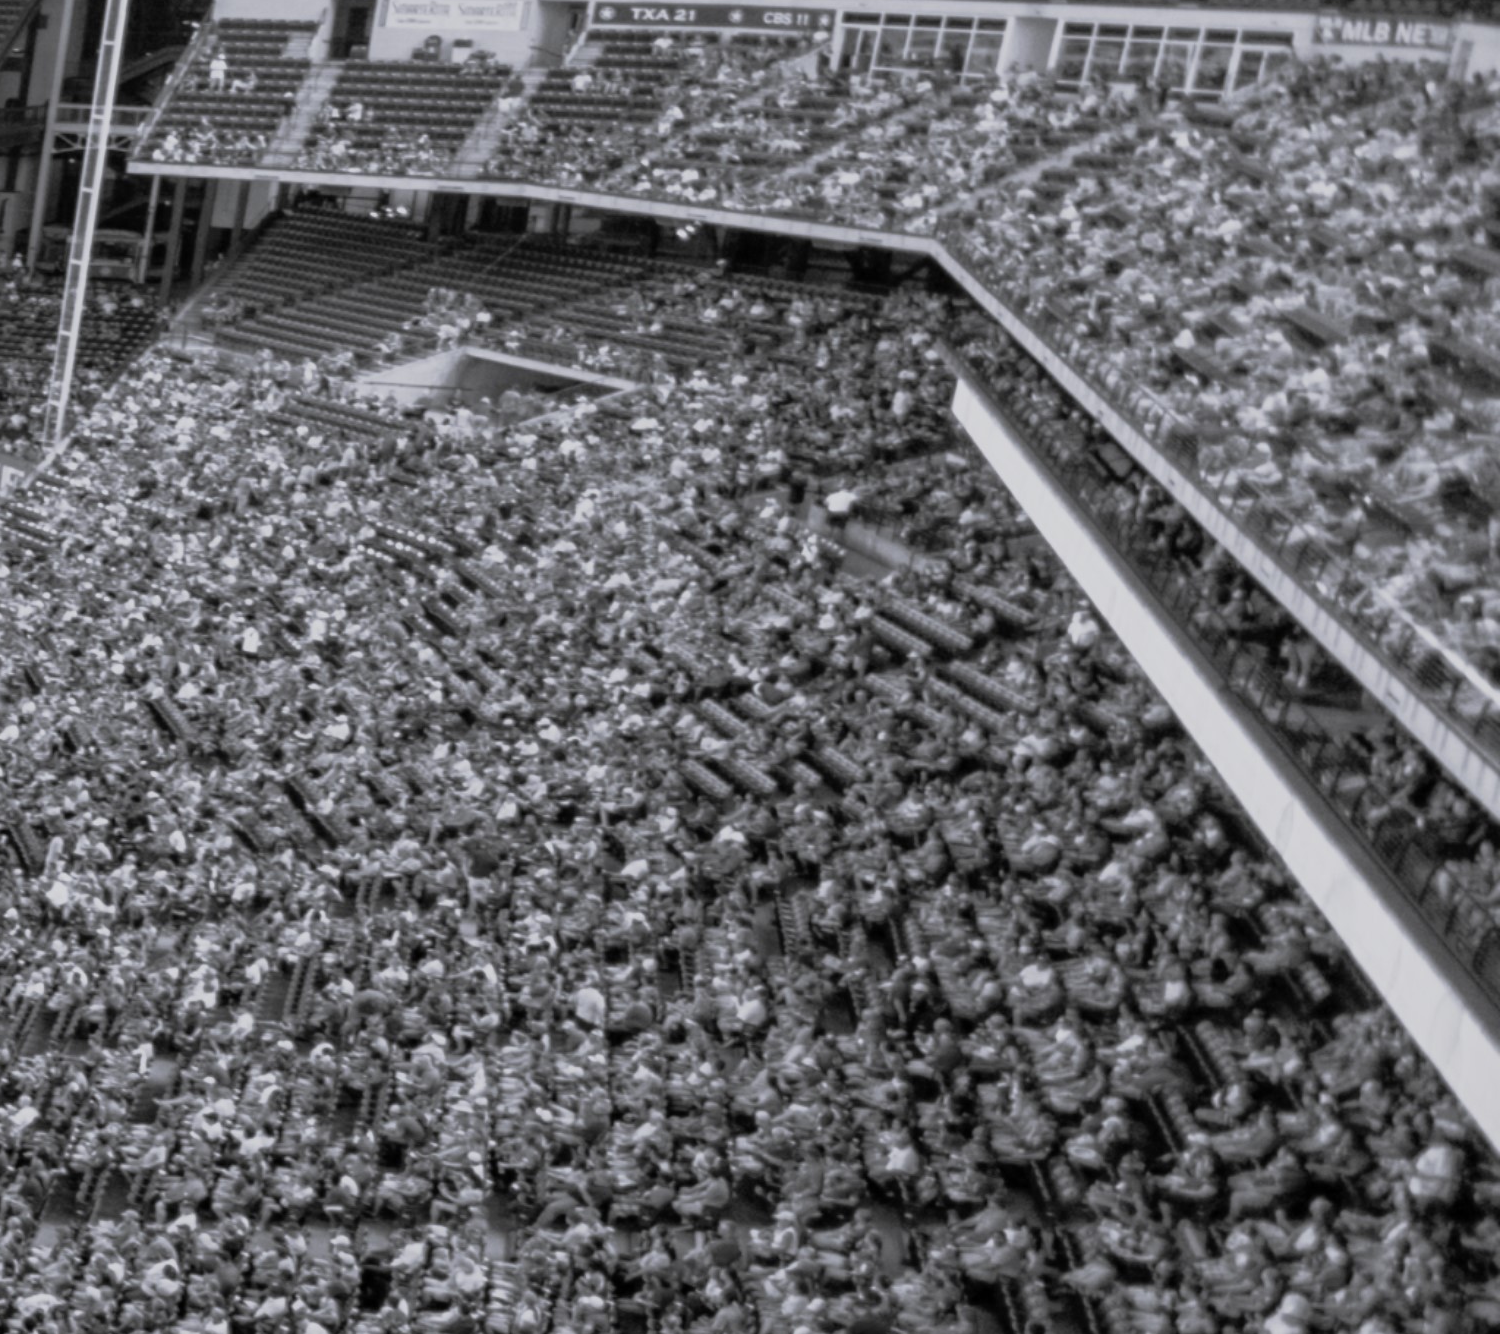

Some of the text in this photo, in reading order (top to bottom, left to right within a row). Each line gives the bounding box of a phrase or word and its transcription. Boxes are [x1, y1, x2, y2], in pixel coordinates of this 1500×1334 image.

[630, 6, 809, 26] TXA 21 CBS 11
[1342, 20, 1389, 42] MLB
